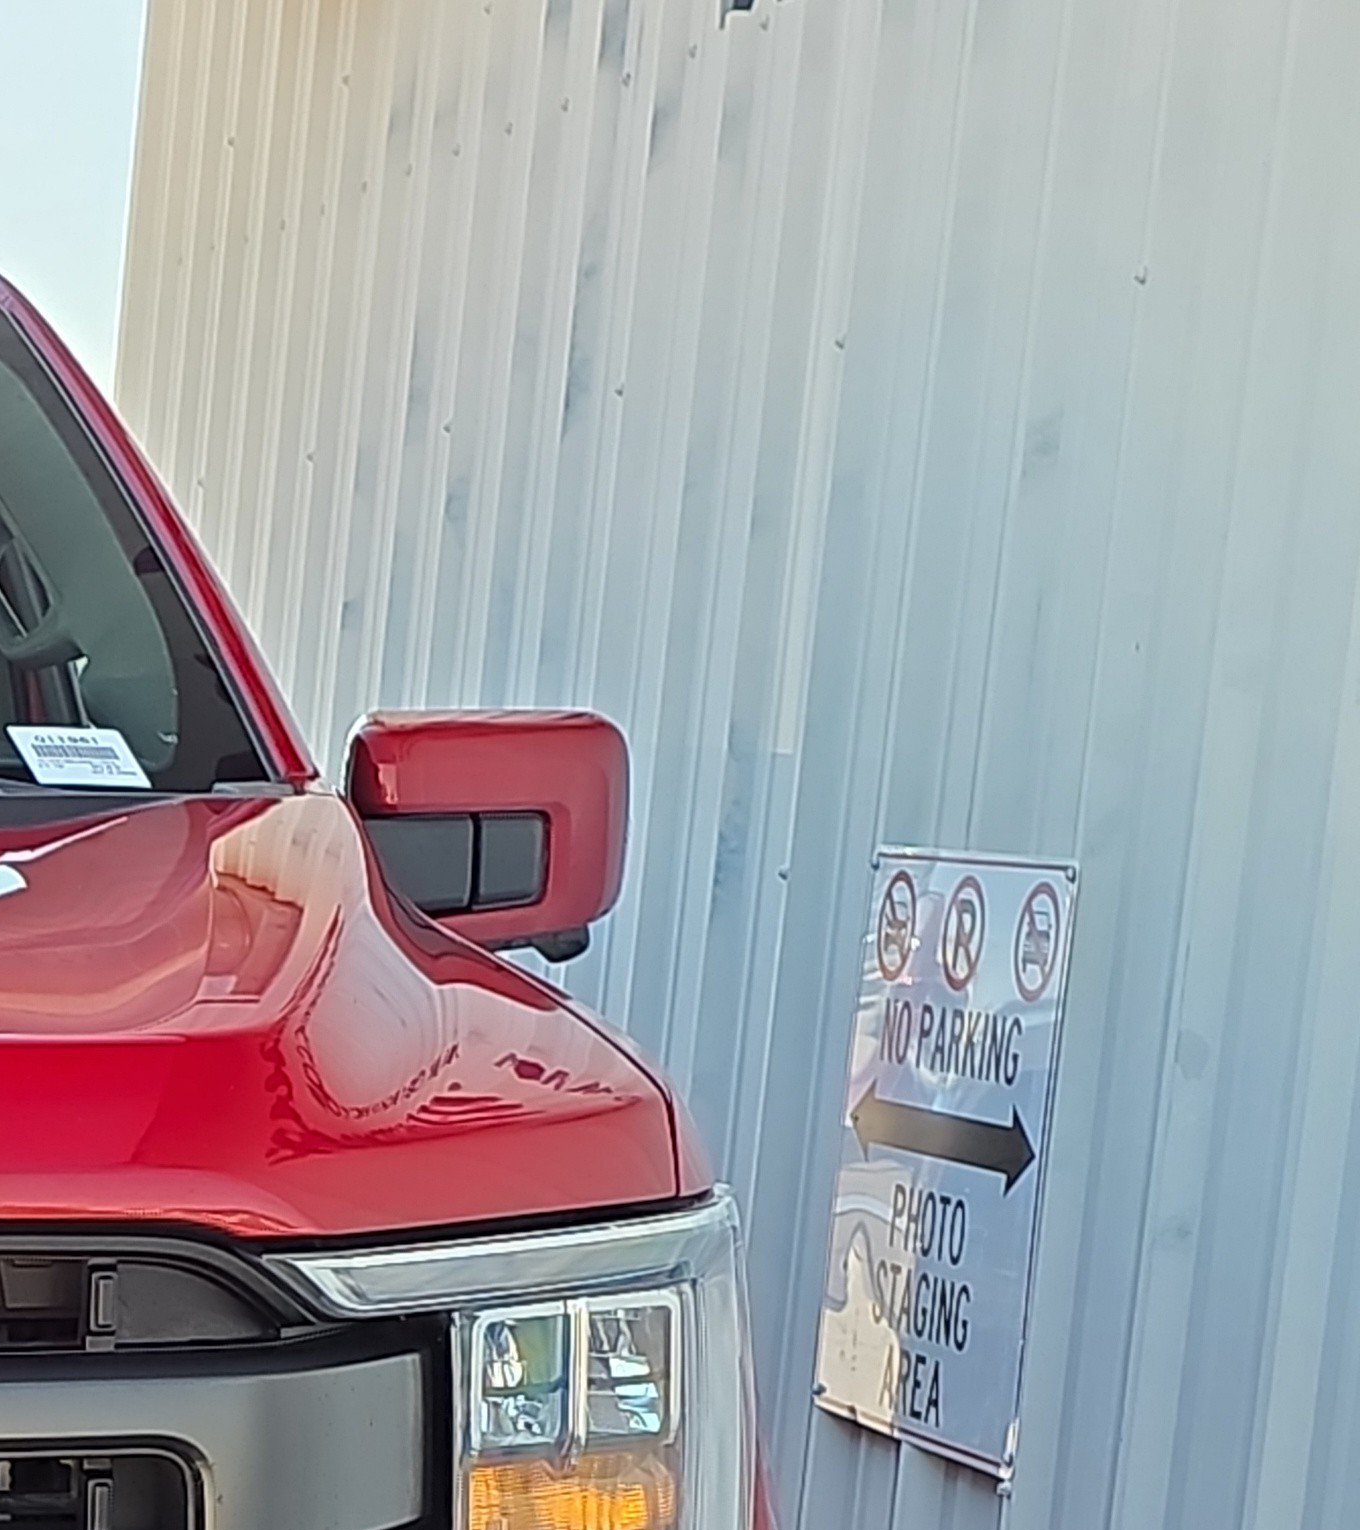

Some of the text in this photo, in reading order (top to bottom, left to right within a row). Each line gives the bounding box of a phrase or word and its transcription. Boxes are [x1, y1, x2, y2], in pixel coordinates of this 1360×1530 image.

[880, 997, 1023, 1087] NO PARKING
[888, 1183, 967, 1266] PHOTO
[871, 1259, 971, 1352] STAGING
[878, 1344, 941, 1428] AREA
